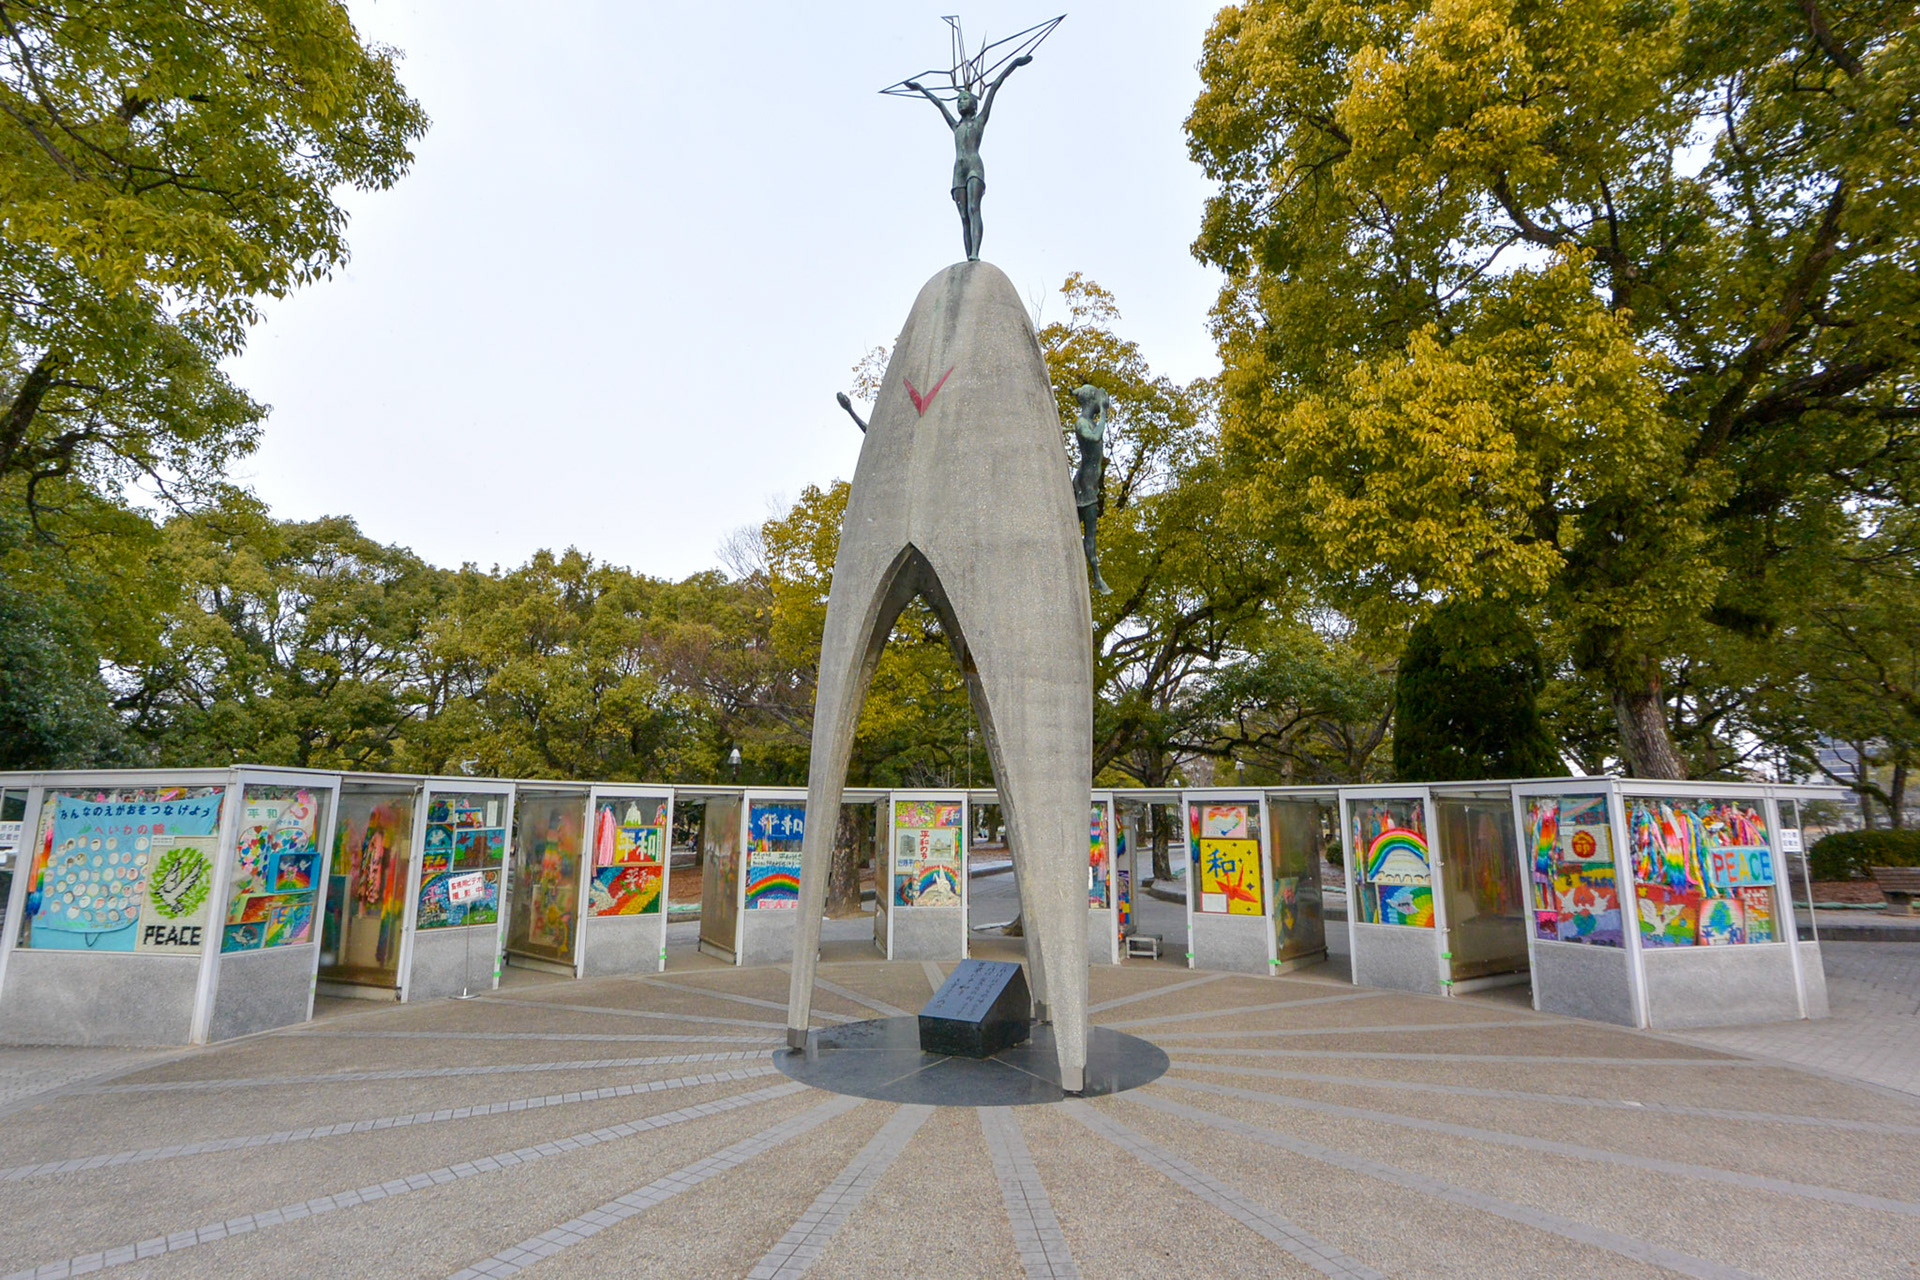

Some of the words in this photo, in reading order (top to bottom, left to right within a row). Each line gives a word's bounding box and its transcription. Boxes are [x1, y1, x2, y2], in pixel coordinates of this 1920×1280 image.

[247, 808, 278, 818] 平和
[758, 813, 803, 835] 平和
[942, 809, 960, 823] 平和
[618, 829, 656, 861] 平和
[1206, 848, 1236, 878] 和
[1712, 851, 1773, 883] PEACE
[623, 868, 657, 891] 平和
[143, 925, 202, 945] PEACE
